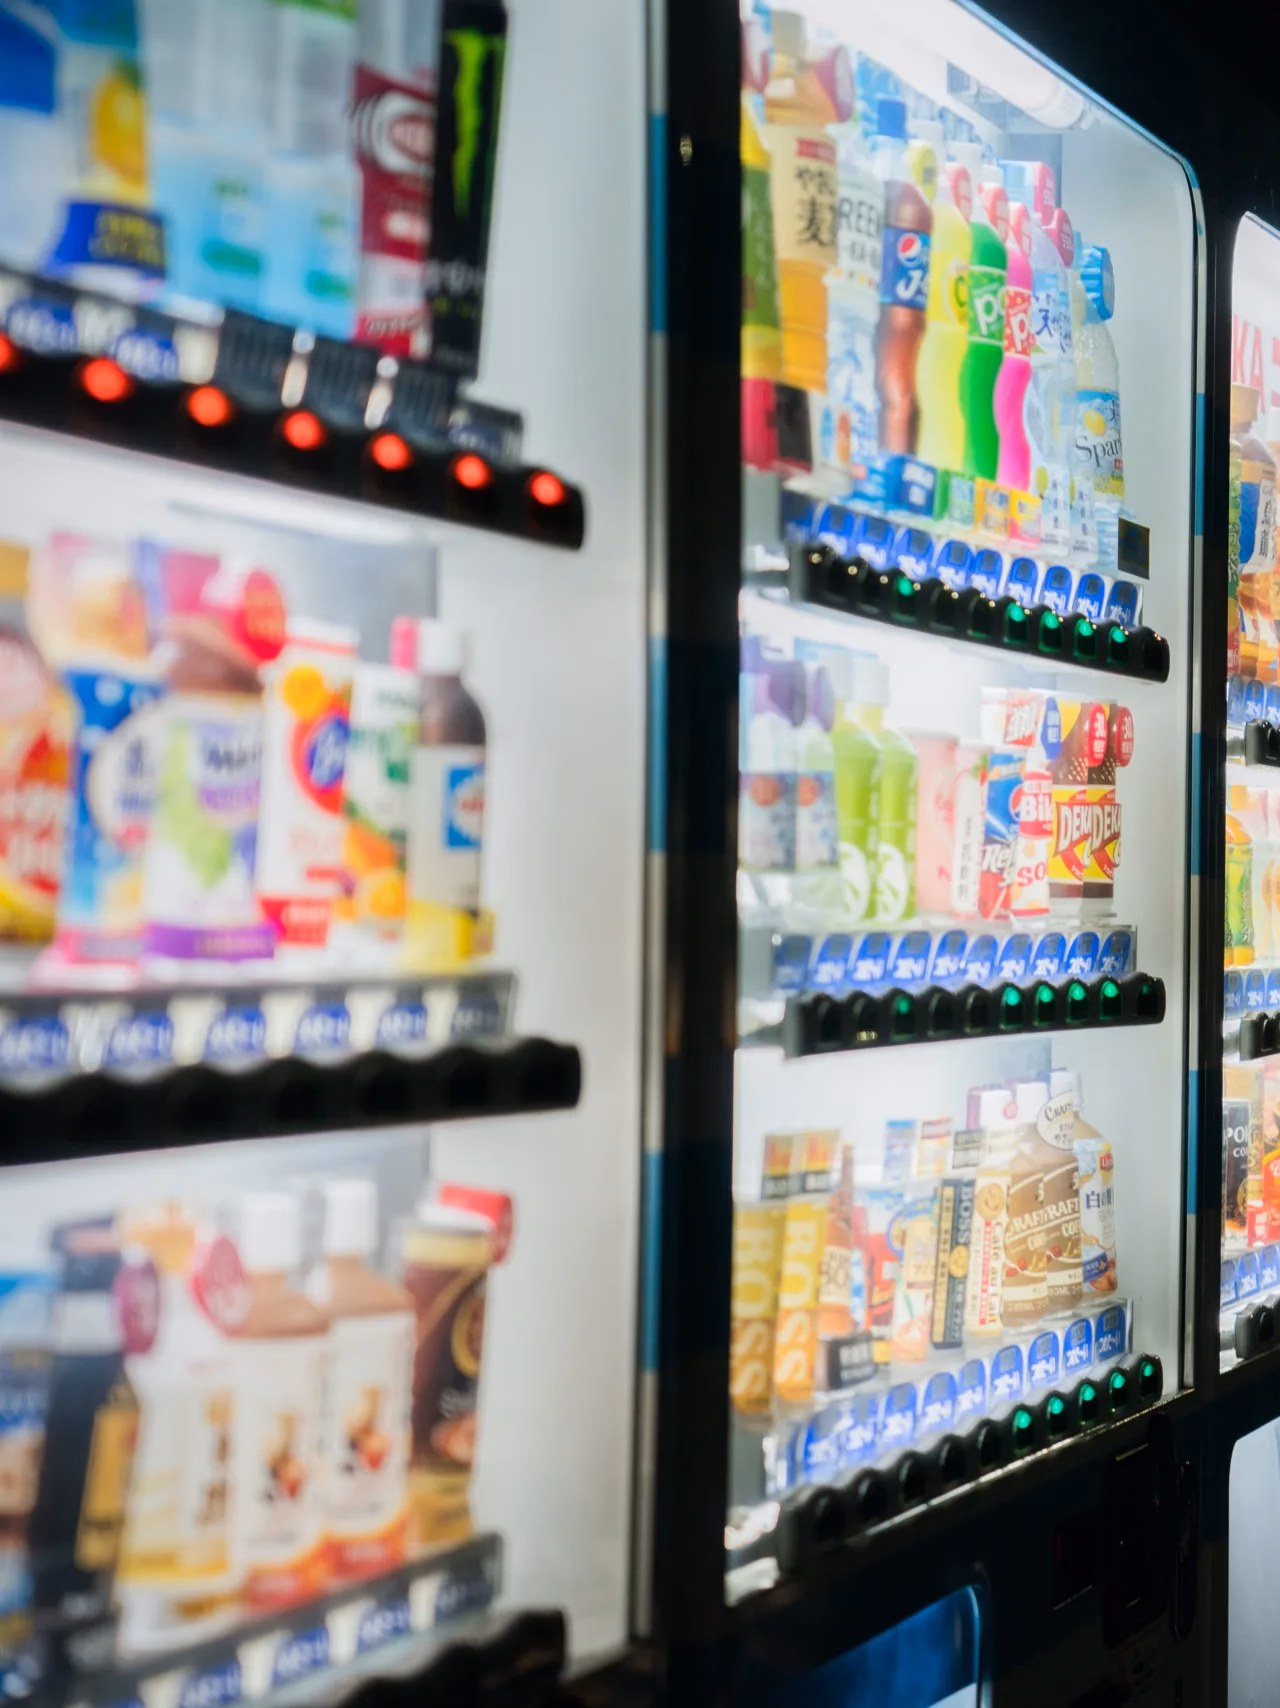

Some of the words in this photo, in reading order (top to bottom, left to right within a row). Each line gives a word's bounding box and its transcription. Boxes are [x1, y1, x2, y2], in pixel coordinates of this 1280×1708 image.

[957, 1185, 974, 1245] BOSS
[1045, 1198, 1080, 1220] RAFT
[730, 1227, 775, 1396] BOSS
[775, 1220, 818, 1384] BOSS
